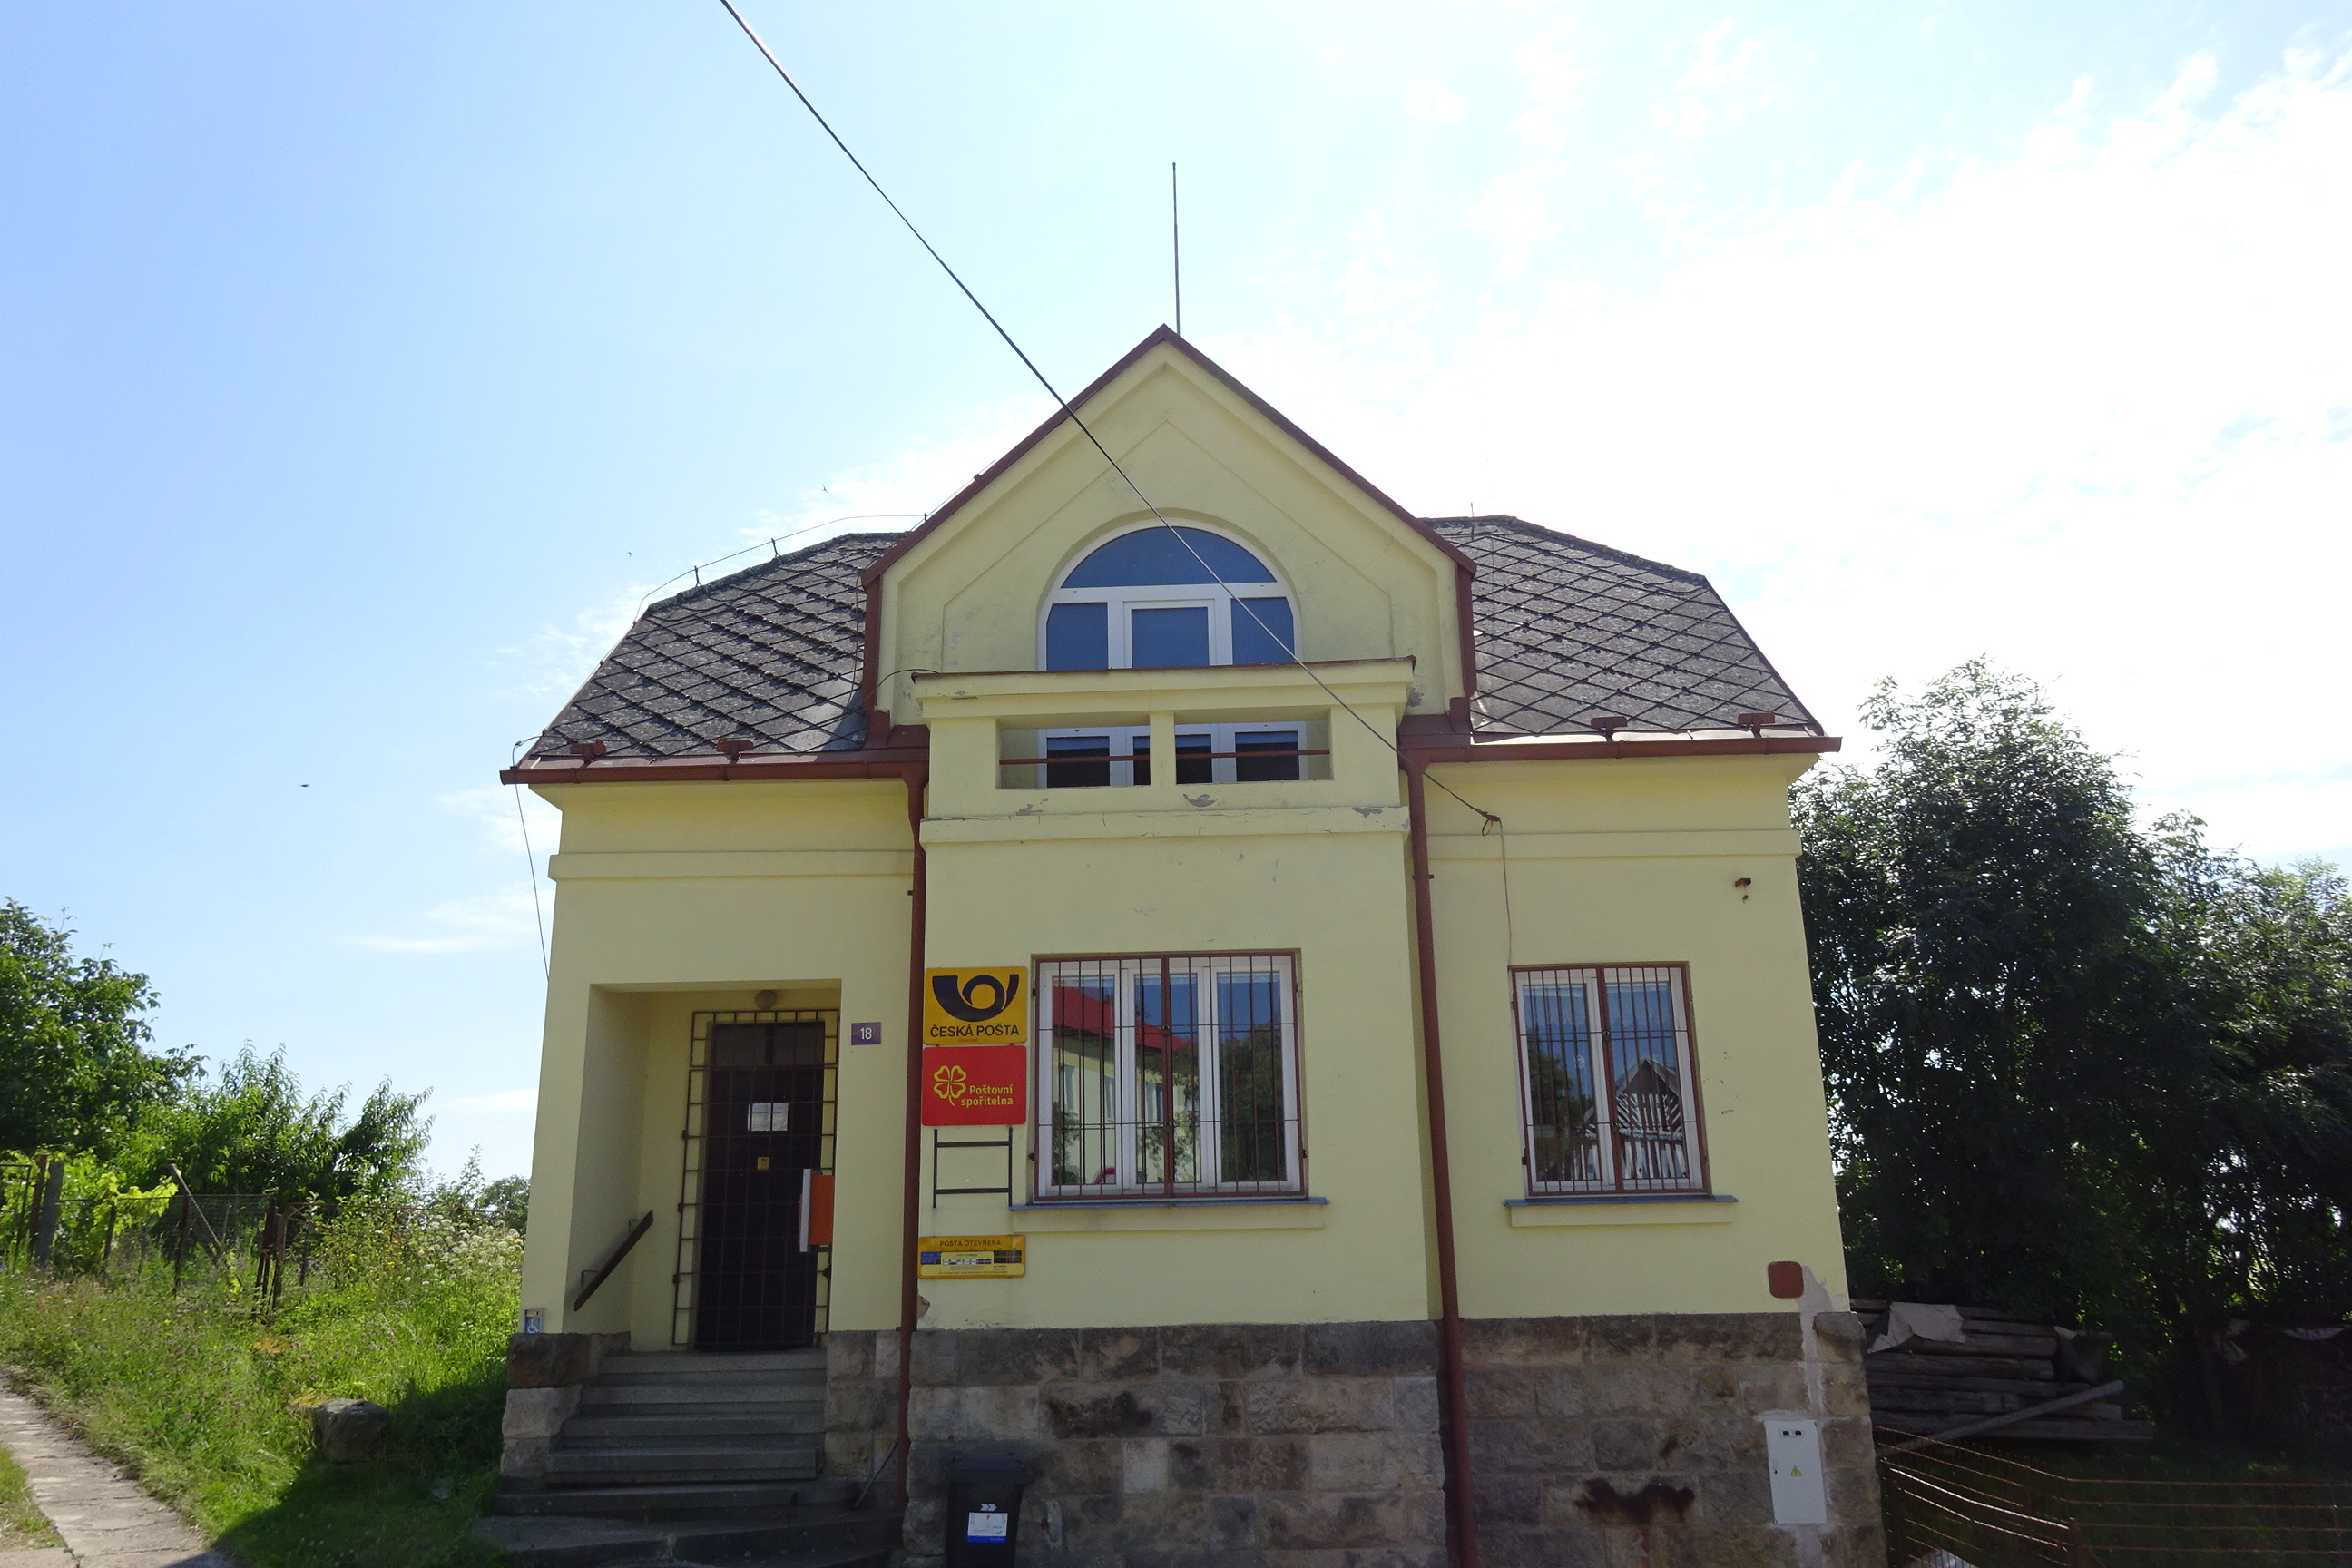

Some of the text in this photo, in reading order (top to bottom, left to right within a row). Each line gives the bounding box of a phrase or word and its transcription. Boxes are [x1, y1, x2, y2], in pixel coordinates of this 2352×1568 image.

[860, 1027, 872, 1040] 18
[930, 1024, 1019, 1037] ČESKÁ POŠTA
[969, 1084, 1014, 1095] Poštovní
[961, 1095, 1014, 1108] spořitelna
